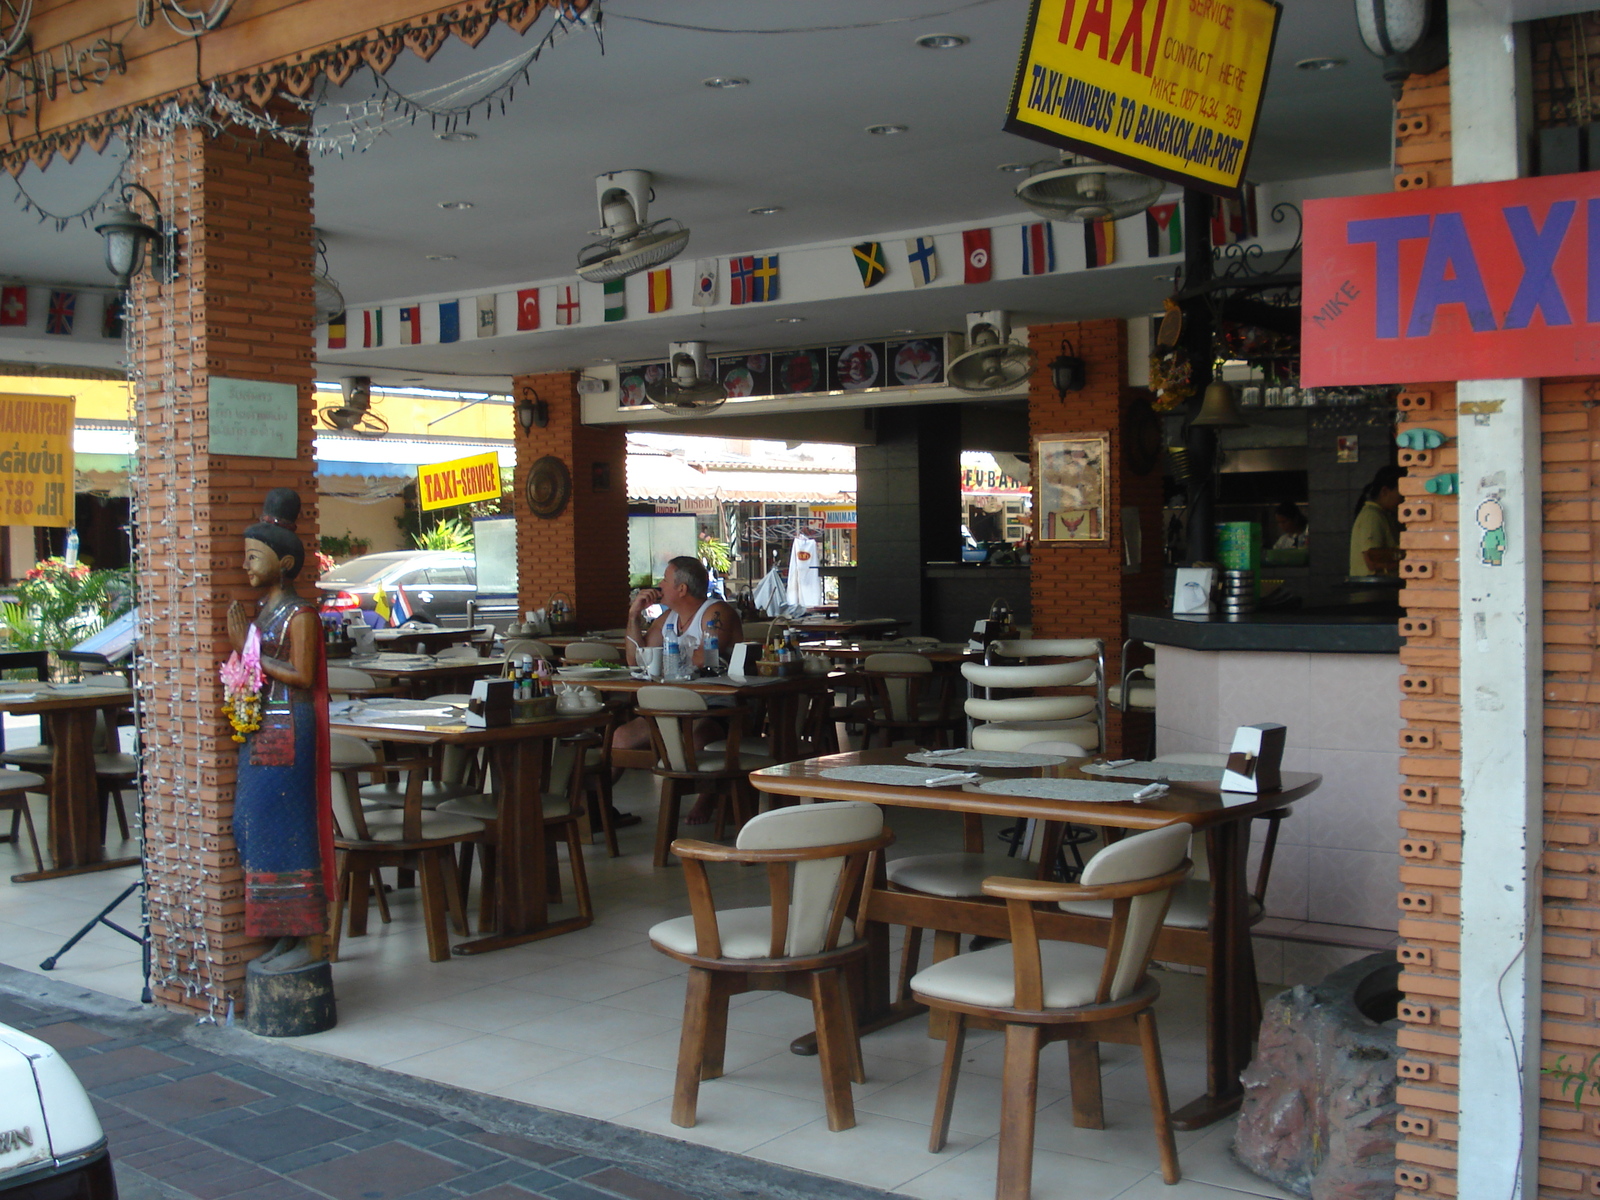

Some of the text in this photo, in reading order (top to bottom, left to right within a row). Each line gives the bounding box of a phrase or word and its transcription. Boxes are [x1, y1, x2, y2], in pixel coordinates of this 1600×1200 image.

[1188, 0, 1234, 30] SERVICE
[1164, 36, 1247, 92] CONTACT HERE
[1027, 64, 1116, 133] TAXI-MINIBUS
[1115, 97, 1136, 140] TO
[1222, 104, 1242, 129] 359
[1346, 198, 1600, 339] TAXI
[1312, 279, 1361, 329] MIKE
[423, 463, 497, 503] TAXI-SERVICE
[827, 511, 858, 523] MINIMAR
